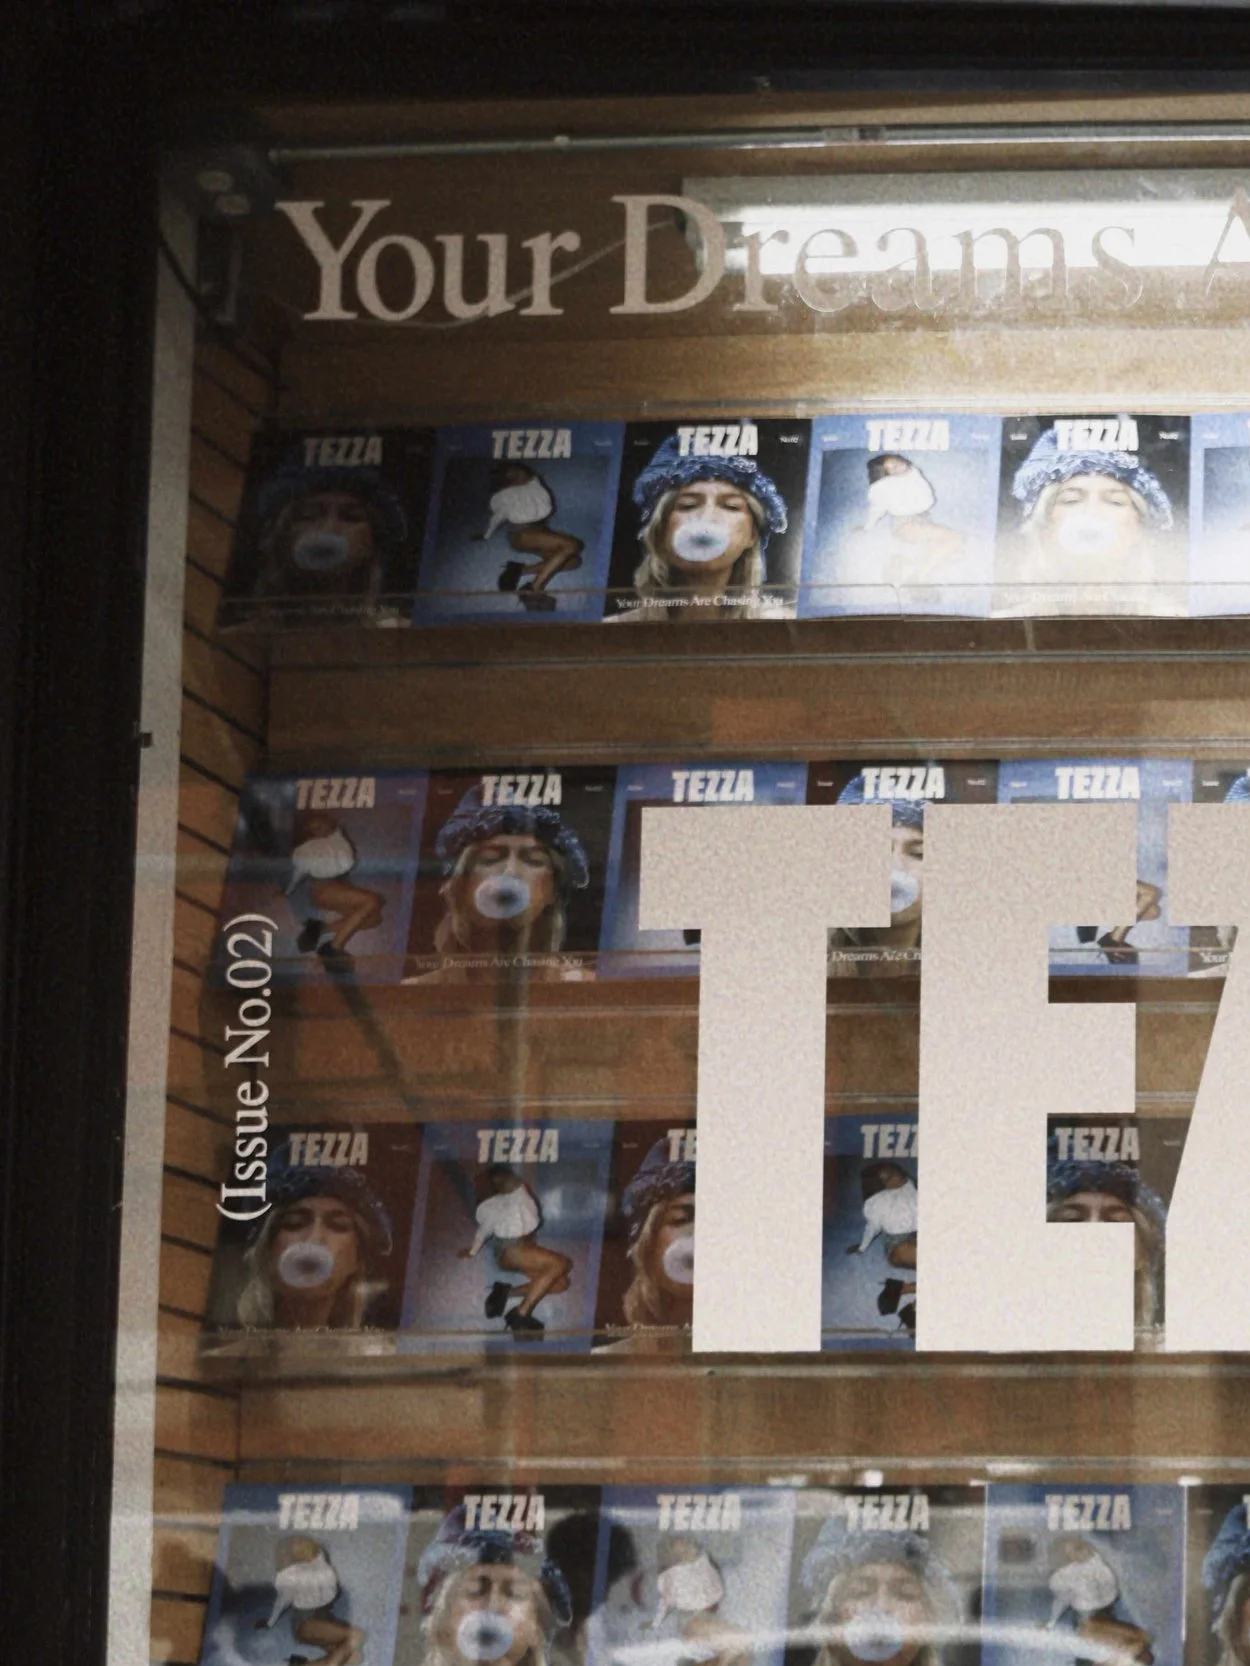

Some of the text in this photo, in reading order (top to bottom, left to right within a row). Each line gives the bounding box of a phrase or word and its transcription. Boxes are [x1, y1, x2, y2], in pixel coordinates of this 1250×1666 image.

[274, 200, 580, 323] Your
[609, 193, 1144, 314] Dreams
[303, 437, 383, 467] TEZZA
[492, 429, 572, 460] TEZZA
[677, 425, 758, 456] TEZZA
[866, 420, 949, 451] TEZZA
[1054, 419, 1139, 451] TEZZA
[642, 597, 689, 607] Dreams
[690, 596, 711, 606] Are
[296, 777, 376, 810] TEZZA
[481, 774, 562, 806] TEZZA
[671, 770, 754, 803] TEZZA
[861, 766, 945, 800] TEZZA
[1055, 766, 1140, 800] TEZZA
[216, 913, 279, 1222] (Issue No.02)
[289, 1132, 369, 1166] TEZZA
[476, 1129, 559, 1163] TEZZA
[1054, 1126, 1140, 1161] TEZZA
[277, 1493, 360, 1531] TEZZA
[463, 1495, 545, 1531] TEZZA
[656, 1495, 741, 1531] TEZZA
[846, 1495, 930, 1531] TEZZA
[1044, 1494, 1131, 1531] TEZZA
